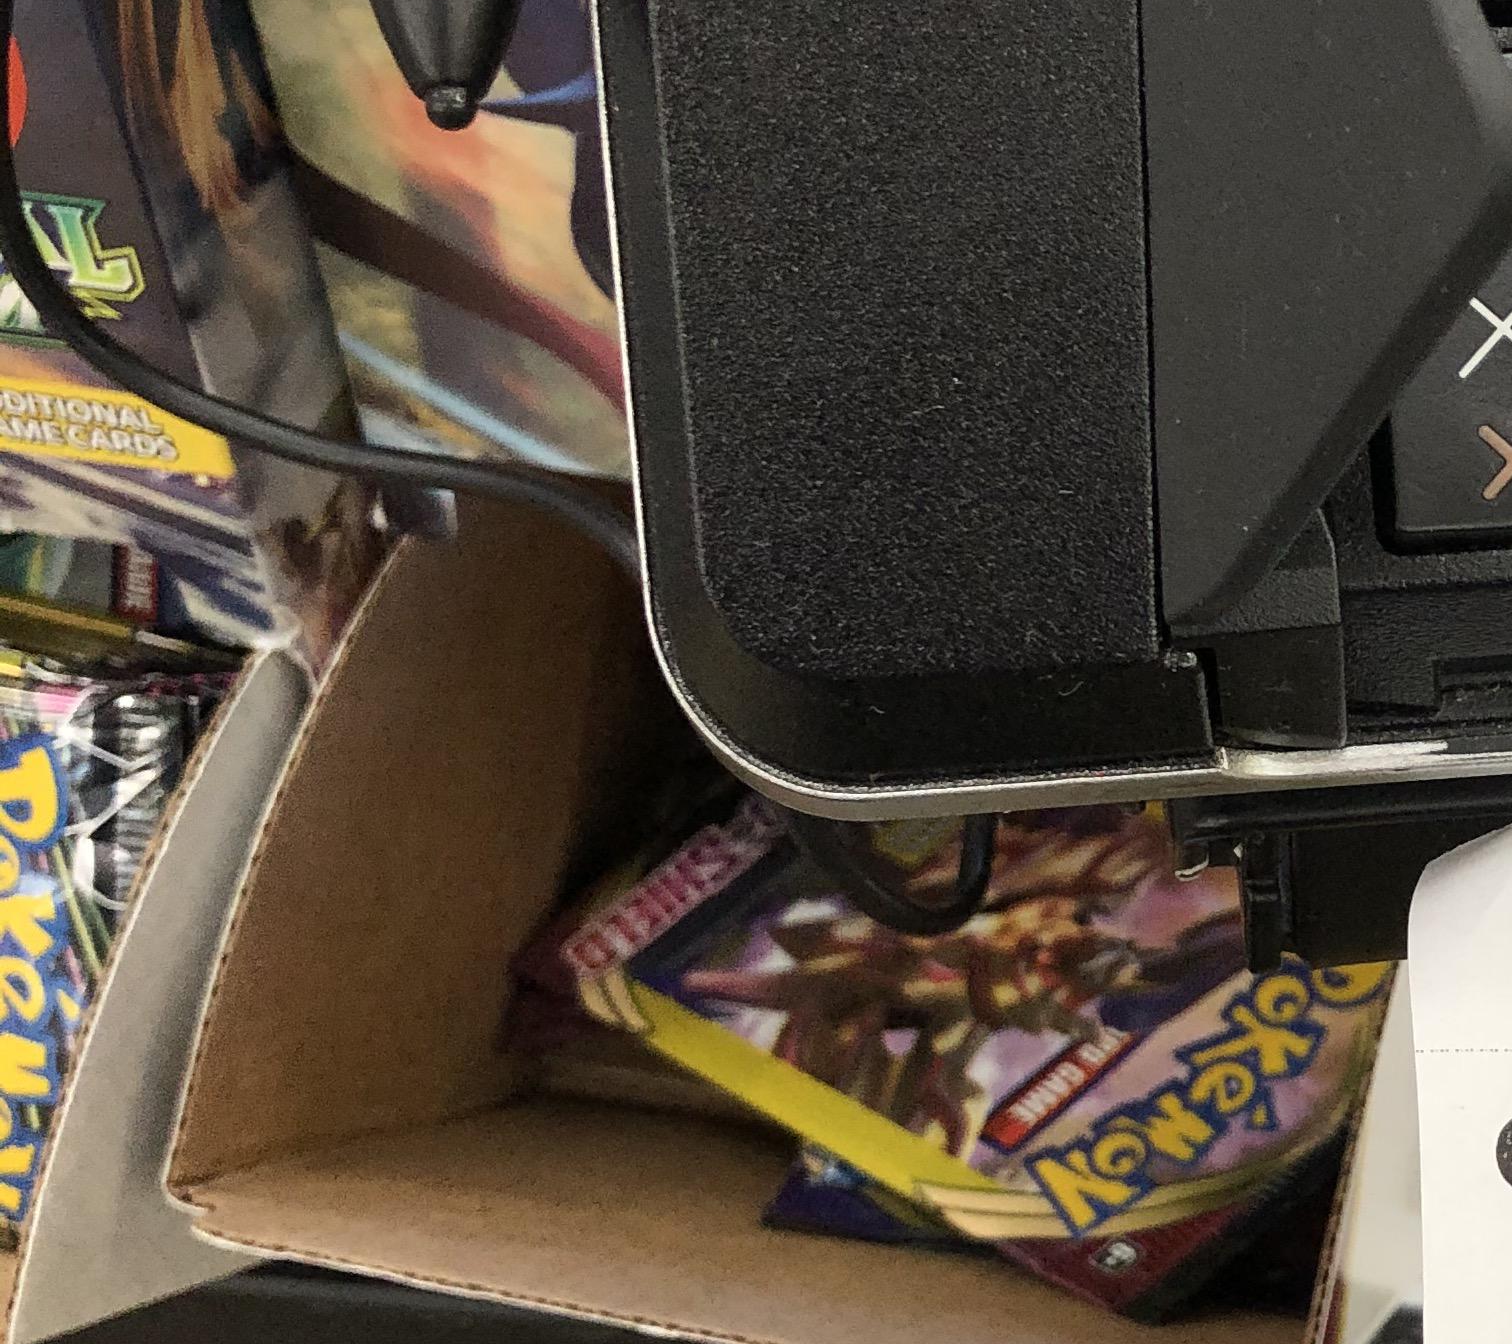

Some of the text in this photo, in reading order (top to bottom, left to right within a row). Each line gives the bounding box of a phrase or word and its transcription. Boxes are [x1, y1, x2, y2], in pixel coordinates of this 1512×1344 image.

[0, 389, 163, 436] DITIONAL
[0, 416, 179, 463] AME CARDS
